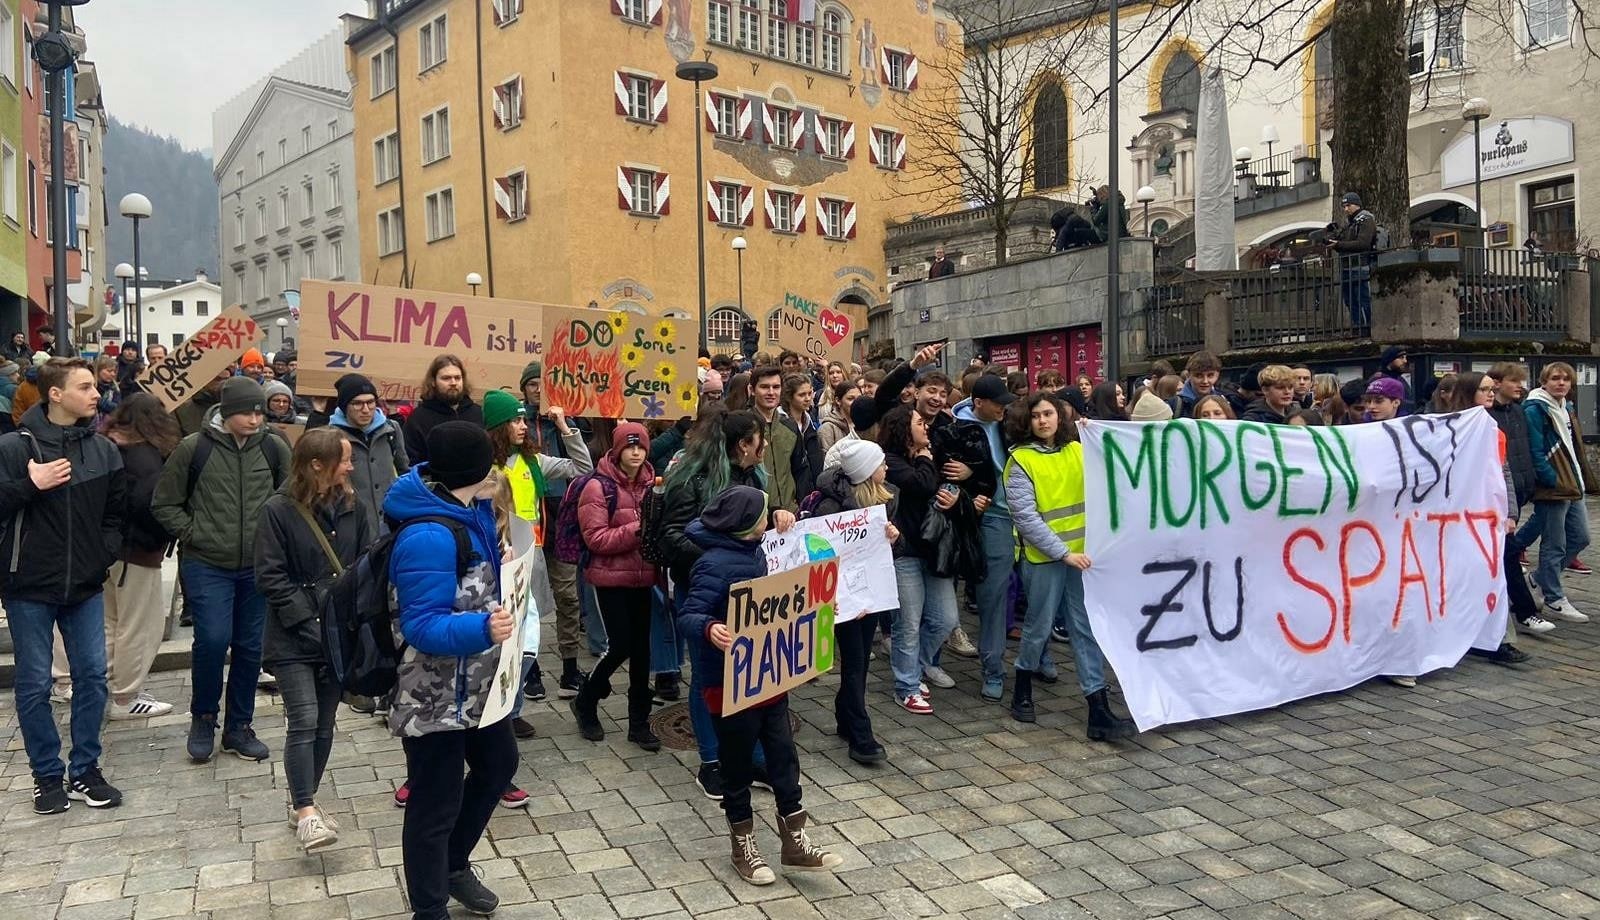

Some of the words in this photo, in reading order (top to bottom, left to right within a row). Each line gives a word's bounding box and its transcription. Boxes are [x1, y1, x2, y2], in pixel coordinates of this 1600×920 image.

[785, 292, 818, 318] MAKE
[212, 318, 240, 331] ZU
[328, 290, 472, 348] KLIMA
[486, 318, 517, 353] ist
[570, 319, 613, 347] DO
[783, 312, 815, 334] NOT
[821, 317, 845, 336] LOVE
[138, 339, 212, 392] MORGEN
[549, 360, 610, 392] thing
[624, 370, 671, 396] Green
[164, 372, 193, 401] IST
[1102, 419, 1360, 532] MORGEN
[1382, 413, 1461, 508] IST
[825, 509, 869, 534] Wandel
[840, 528, 867, 543] 1990
[1136, 556, 1246, 652] ZU
[1276, 510, 1499, 655] SPÄT!
[731, 586, 790, 634] There
[793, 584, 806, 614] is
[808, 561, 838, 609] NO
[731, 611, 817, 704] PLANET
[815, 604, 835, 672] B
